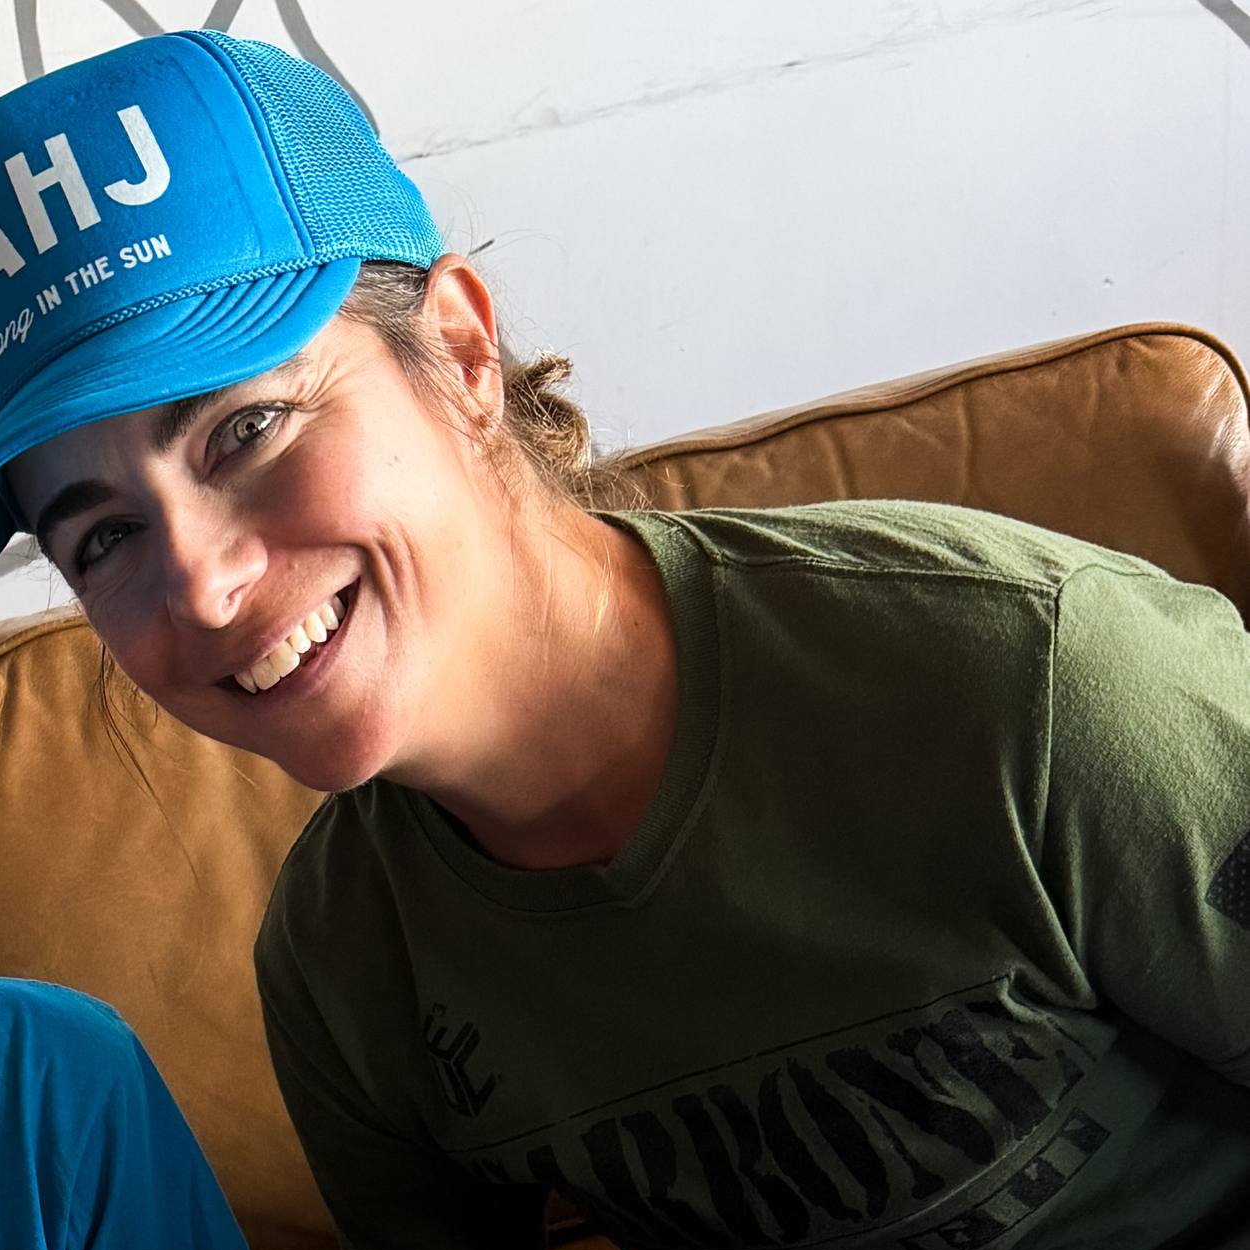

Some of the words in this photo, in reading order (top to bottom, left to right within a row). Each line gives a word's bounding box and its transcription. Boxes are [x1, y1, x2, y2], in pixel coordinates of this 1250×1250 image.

[37, 290, 62, 315] IN
[65, 257, 115, 296] THE
[120, 235, 171, 269] SUN
